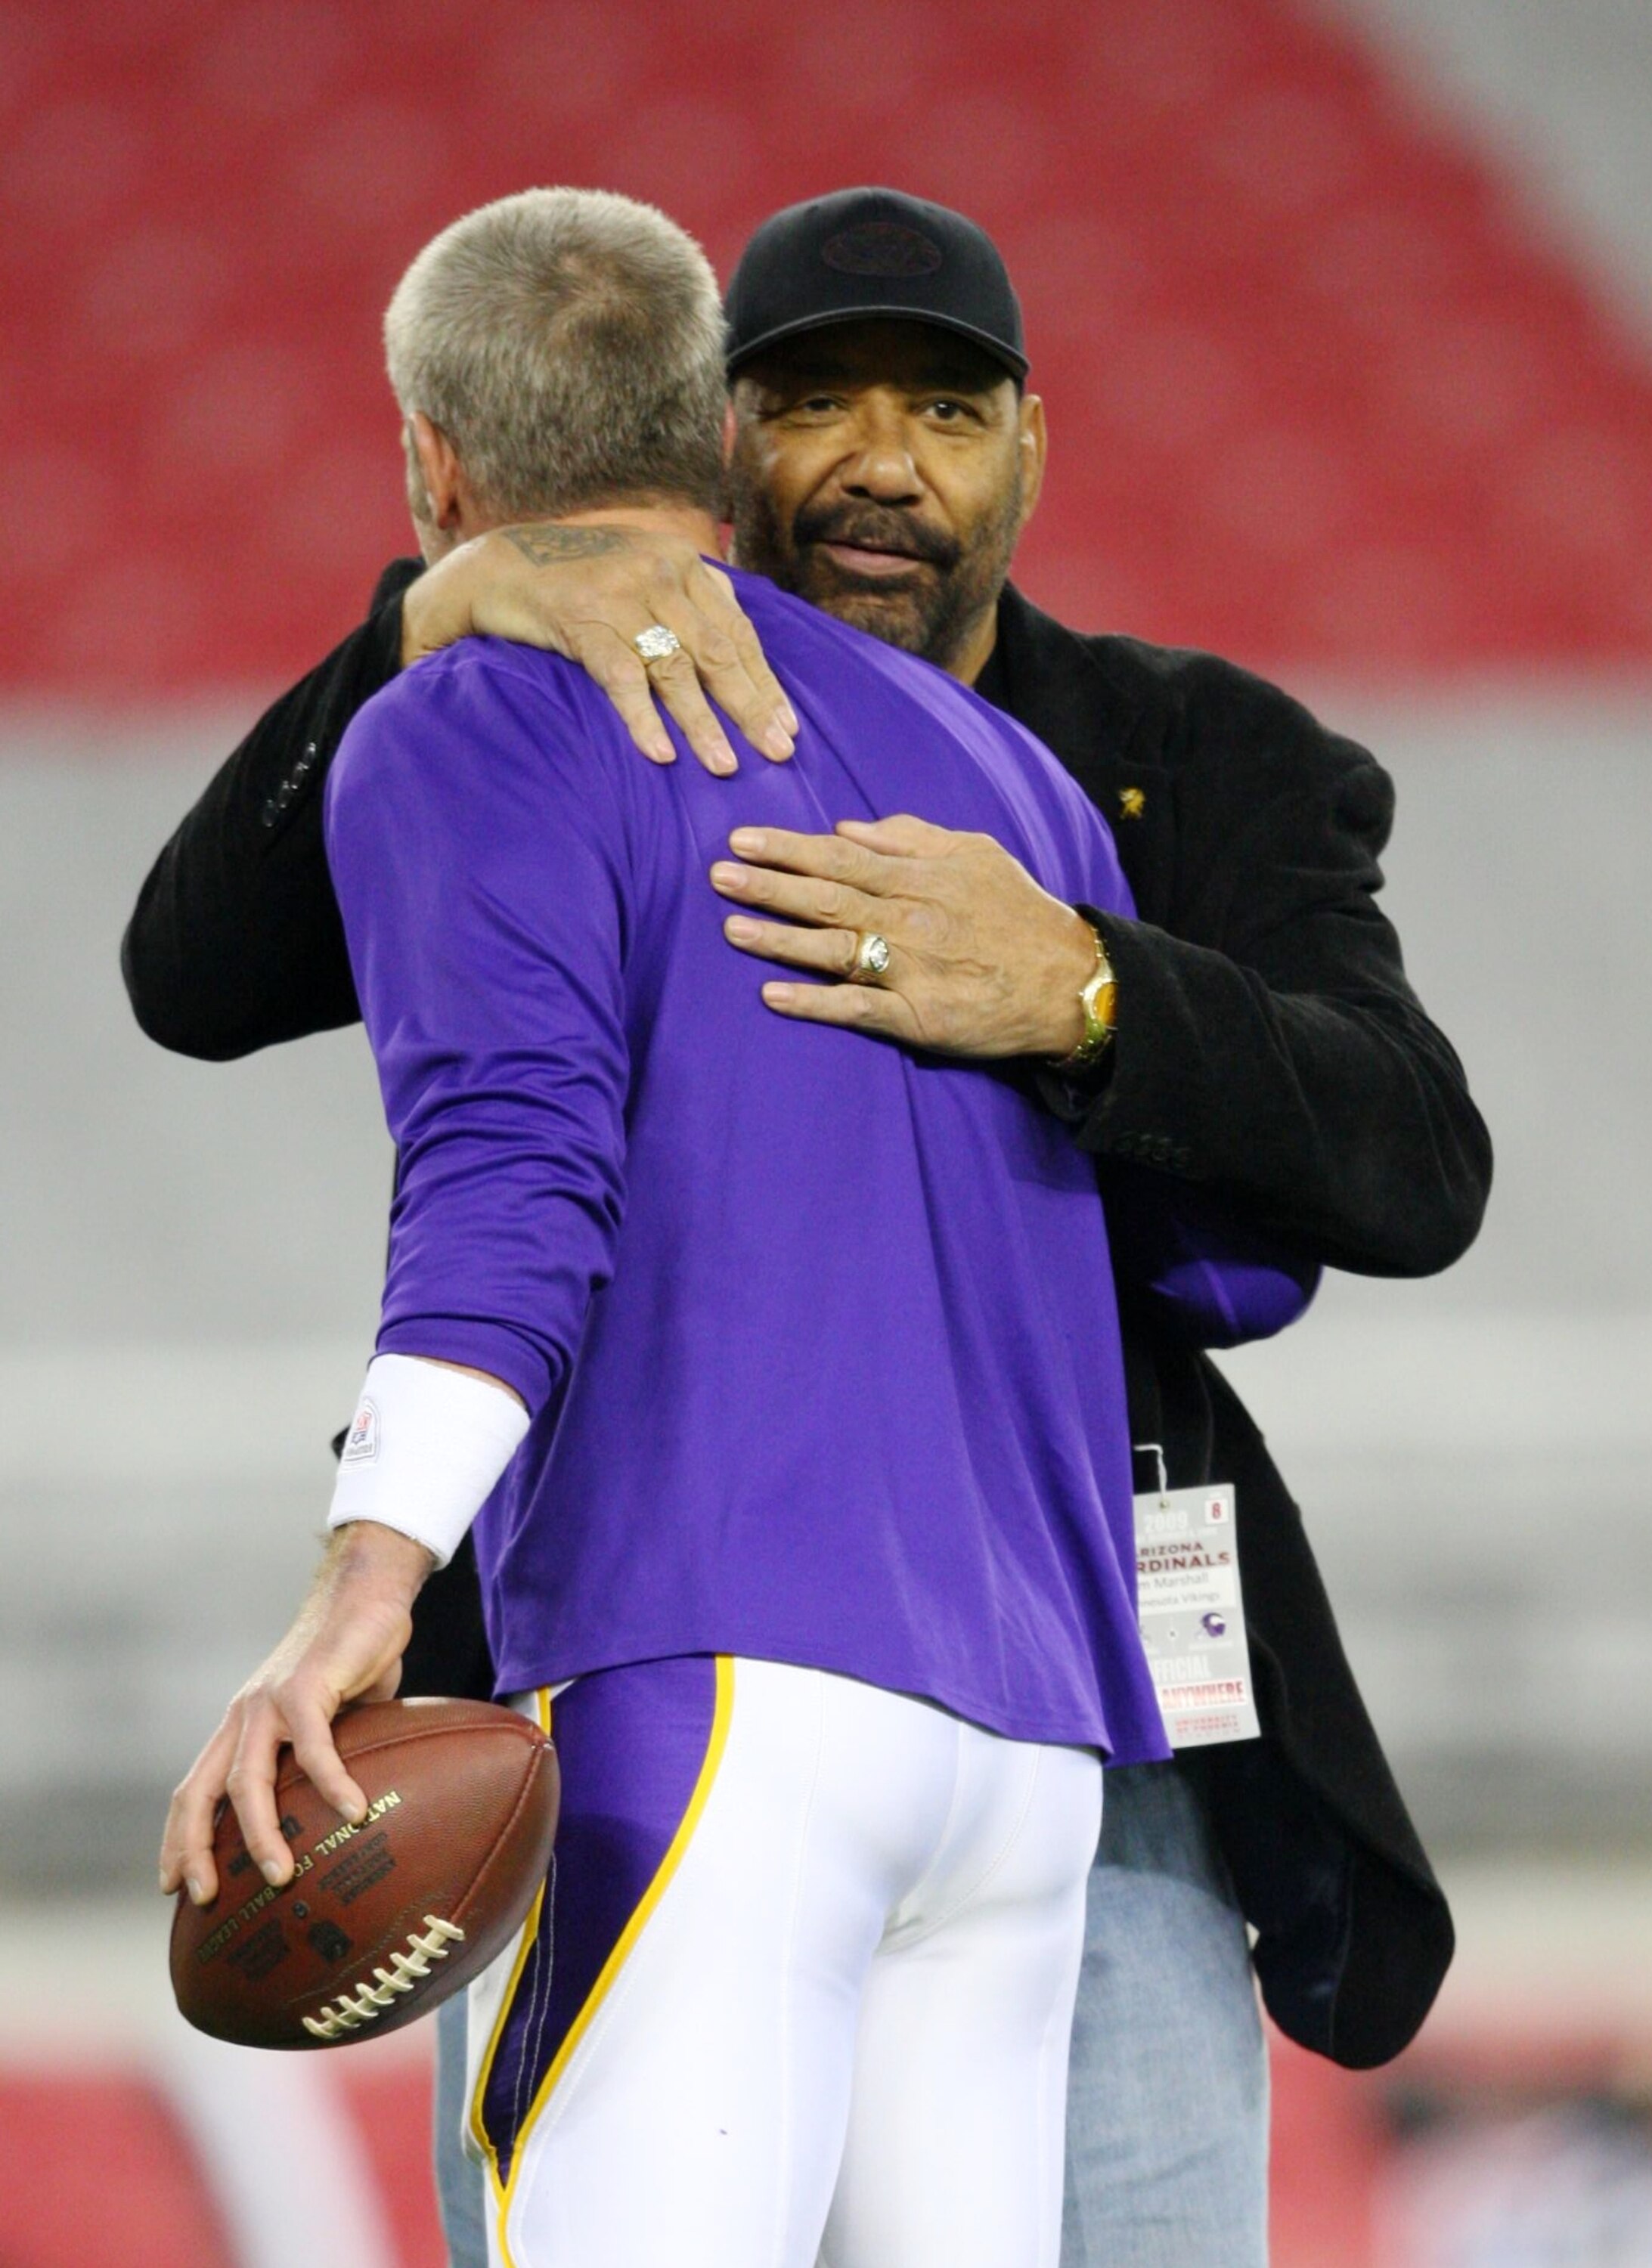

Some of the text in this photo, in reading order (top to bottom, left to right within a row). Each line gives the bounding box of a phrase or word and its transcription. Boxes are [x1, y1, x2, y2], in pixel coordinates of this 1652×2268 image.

[1144, 1510, 1188, 1533] 2009
[1212, 1502, 1221, 1520] 8
[1137, 1541, 1204, 1557] RIZONA
[1137, 1552, 1230, 1572] RDINALS
[1155, 1572, 1209, 1588] Marshall
[1151, 1654, 1213, 1681] FFICIAL
[315, 1790, 401, 1855] NATONAL
[239, 1854, 315, 1920] FOBALL
